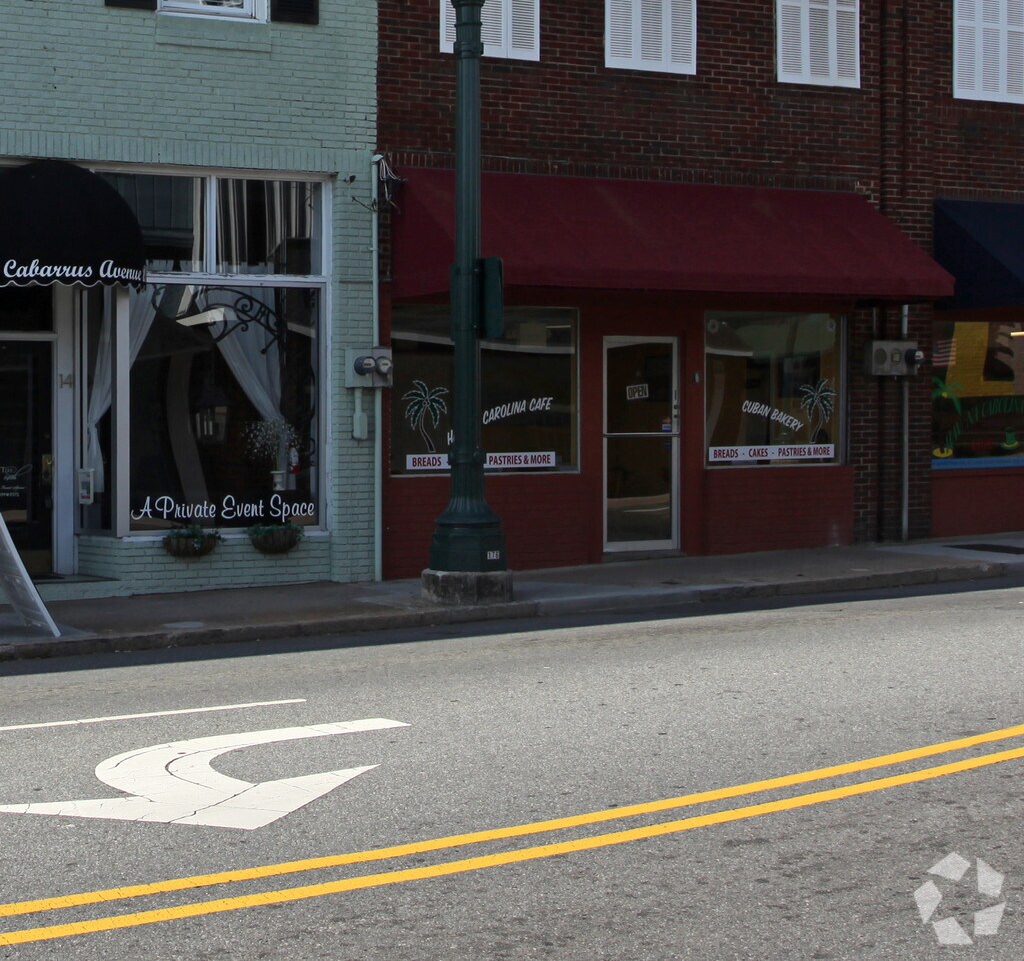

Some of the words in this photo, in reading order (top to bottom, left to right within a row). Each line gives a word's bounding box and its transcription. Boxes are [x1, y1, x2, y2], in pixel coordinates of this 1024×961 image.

[3, 258, 93, 278] Cabarrus
[99, 259, 143, 281] Avenue
[58, 373, 74, 389] 14
[628, 385, 647, 398] OPEN
[482, 399, 526, 425] CAROLINA
[529, 397, 553, 412] CAFE
[741, 400, 771, 418] CUBAN
[770, 408, 804, 432] BAKERY
[412, 456, 442, 467] BREADS
[488, 455, 522, 465] PASTRIES
[523, 455, 529, 464] &
[530, 454, 551, 465] MORE
[713, 449, 738, 458] BREADS
[748, 448, 768, 458] CAKES
[778, 447, 806, 457] PASTRIES
[807, 447, 812, 456] &
[813, 446, 830, 456] MORE
[130, 496, 152, 520] A
[154, 495, 216, 520] Private
[221, 494, 264, 519] Event
[269, 494, 315, 523] Space
